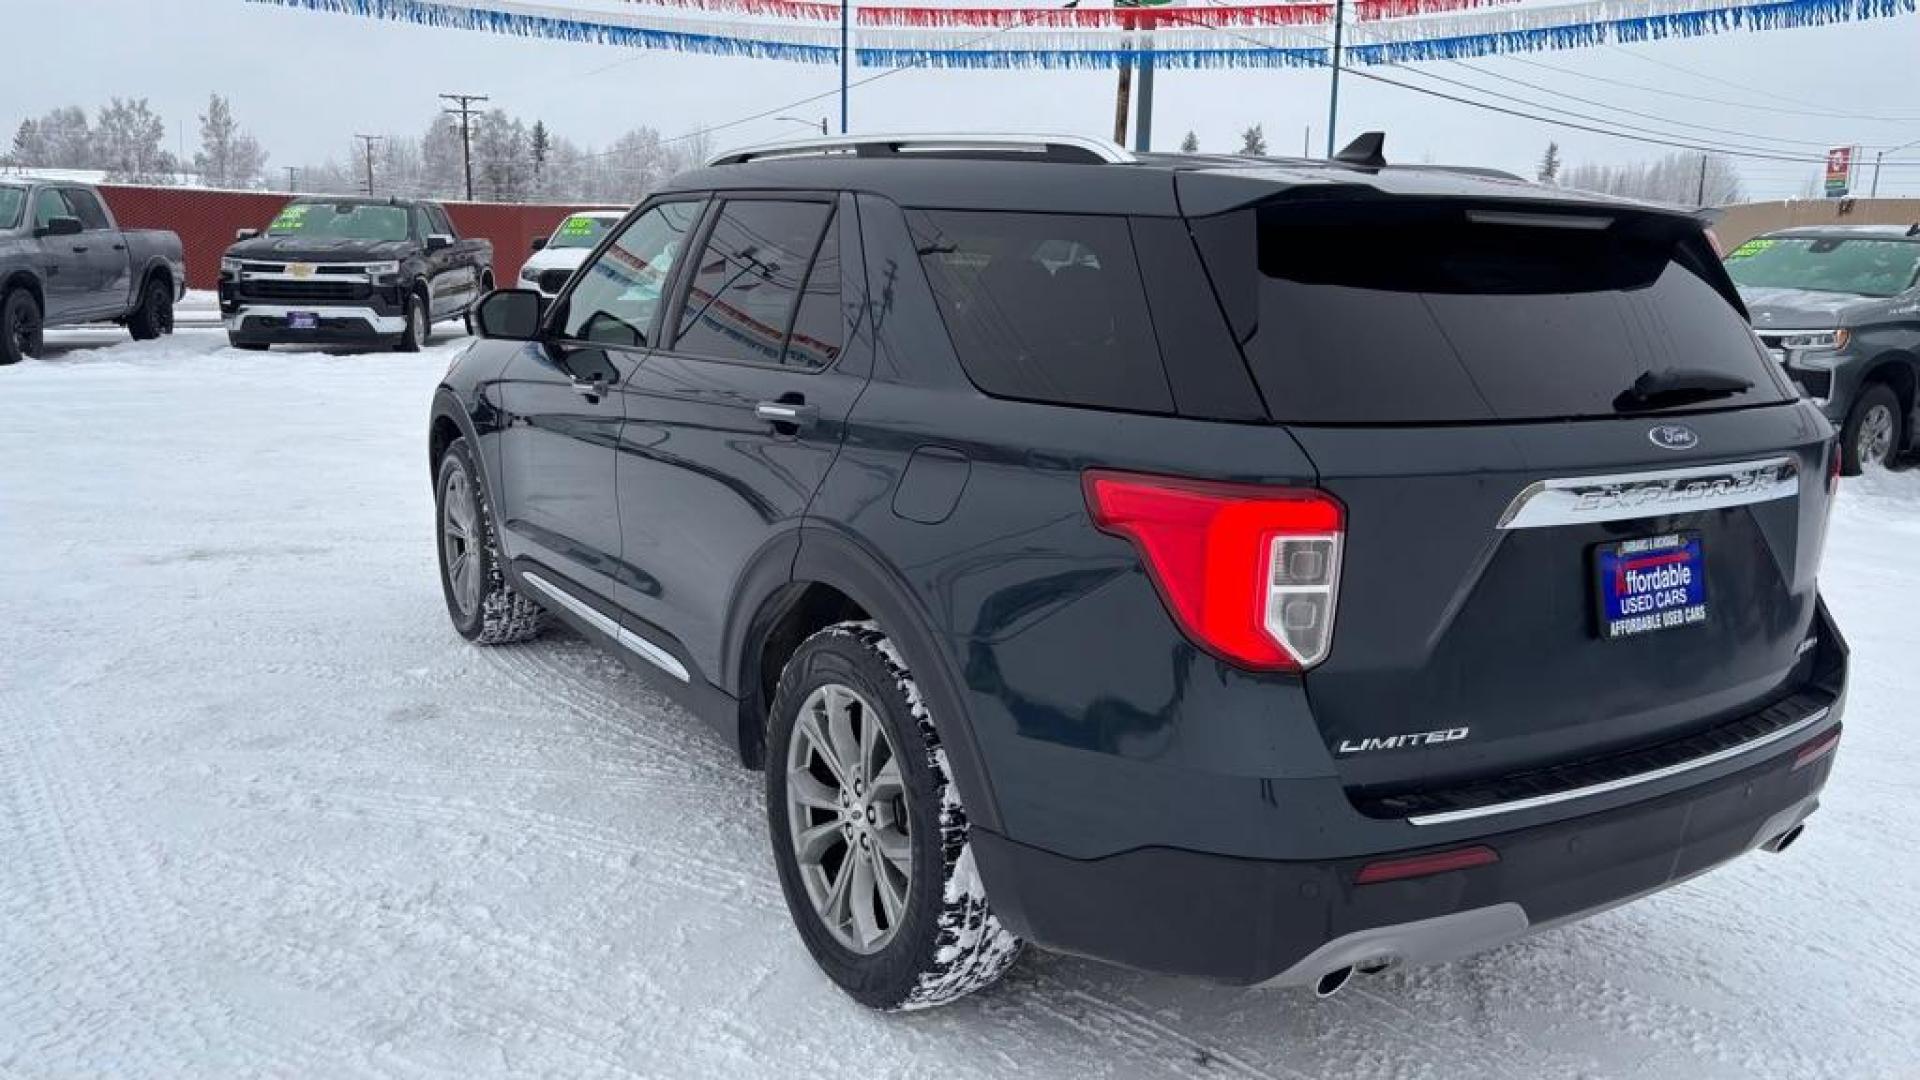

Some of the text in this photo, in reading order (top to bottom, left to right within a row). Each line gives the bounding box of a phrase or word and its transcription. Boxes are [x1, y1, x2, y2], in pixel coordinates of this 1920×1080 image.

[1574, 468, 1778, 511] EXPLORER
[1616, 562, 1692, 597] Affordable
[1621, 588, 1687, 615] USED CARS
[1610, 604, 1705, 637] AFFORDABLE USED CARS
[1339, 727, 1469, 752] LIMITED
